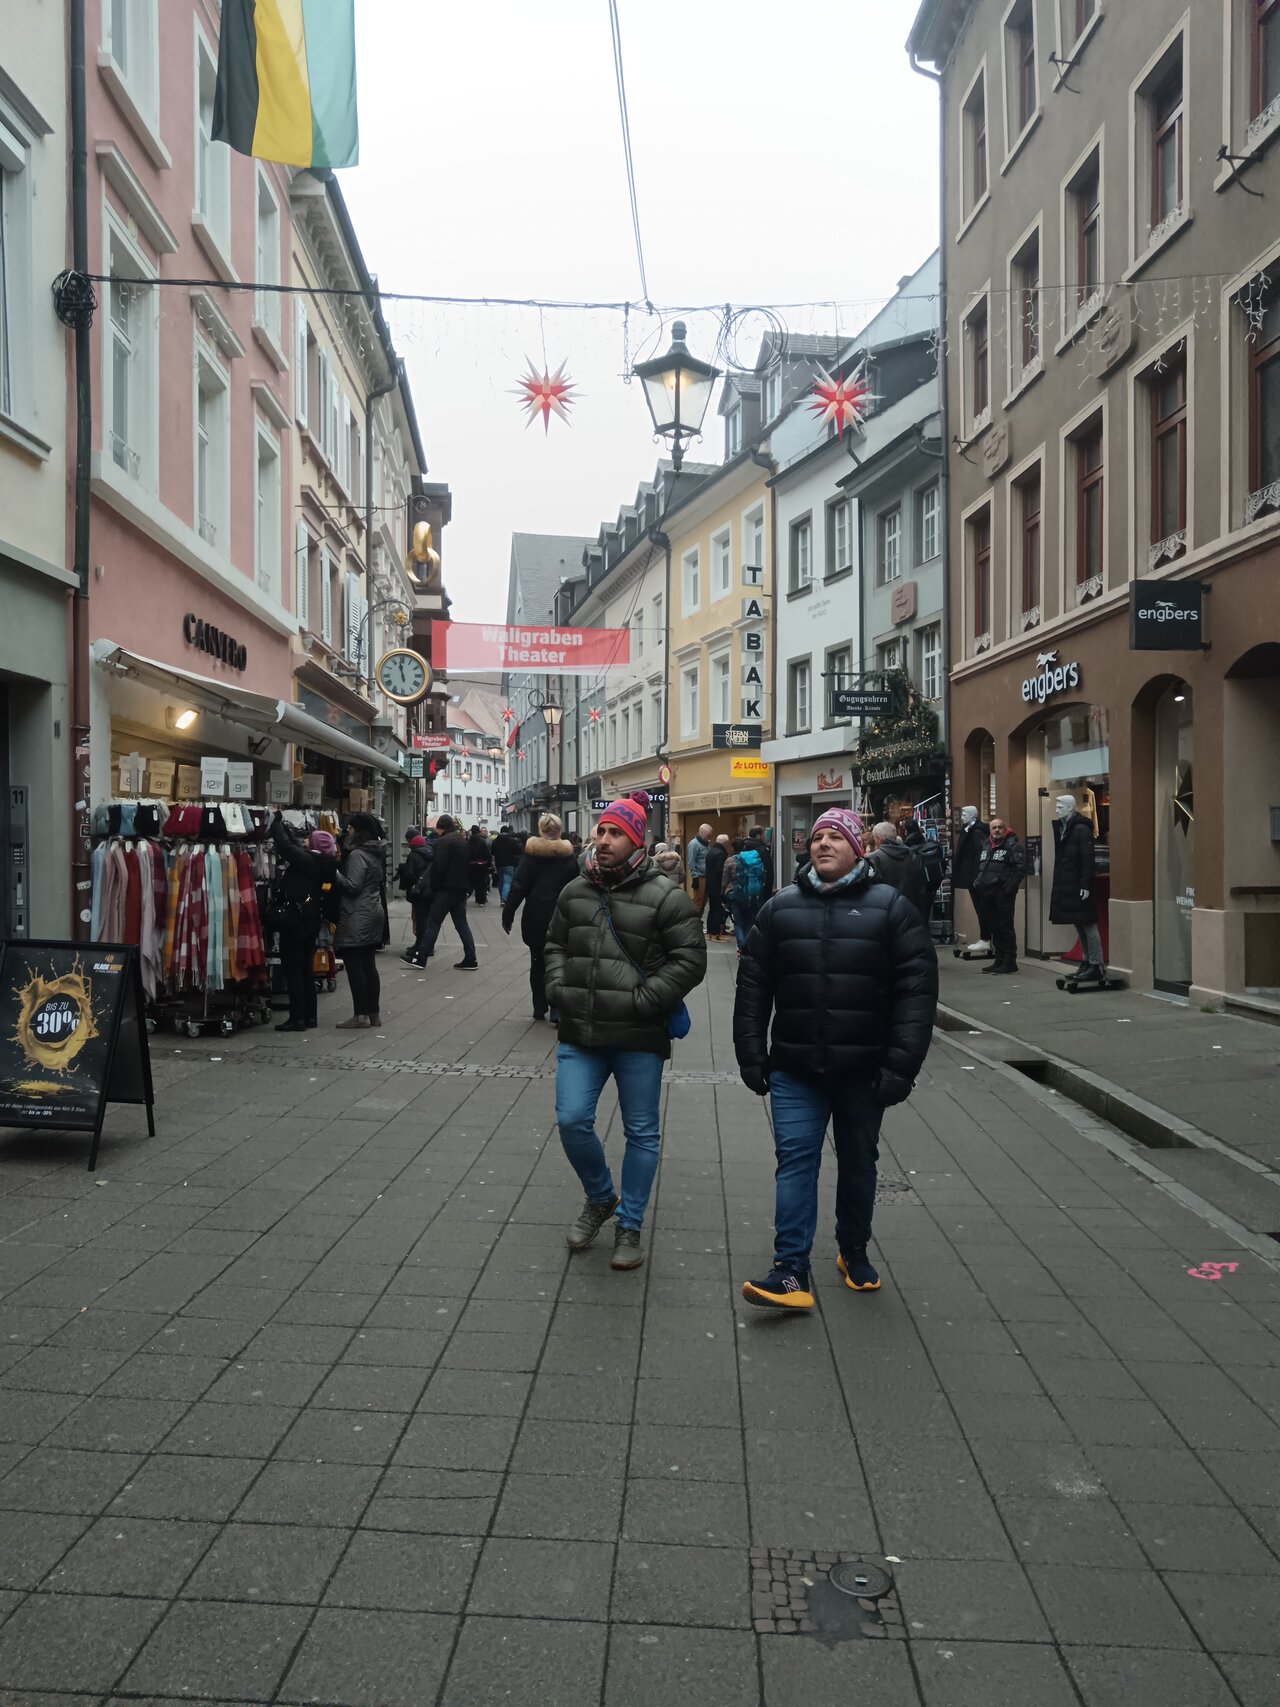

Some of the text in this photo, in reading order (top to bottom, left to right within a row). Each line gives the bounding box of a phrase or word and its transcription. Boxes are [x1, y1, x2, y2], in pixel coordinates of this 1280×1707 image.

[1138, 607, 1199, 622] engbers
[481, 625, 583, 647] Wallgraben
[746, 566, 762, 717] TABAK
[498, 645, 567, 664] Theater
[1021, 661, 1079, 704] engbers
[12, 789, 24, 804] 11
[45, 1001, 69, 1012] BIS ZU
[36, 1010, 80, 1035] 30%
